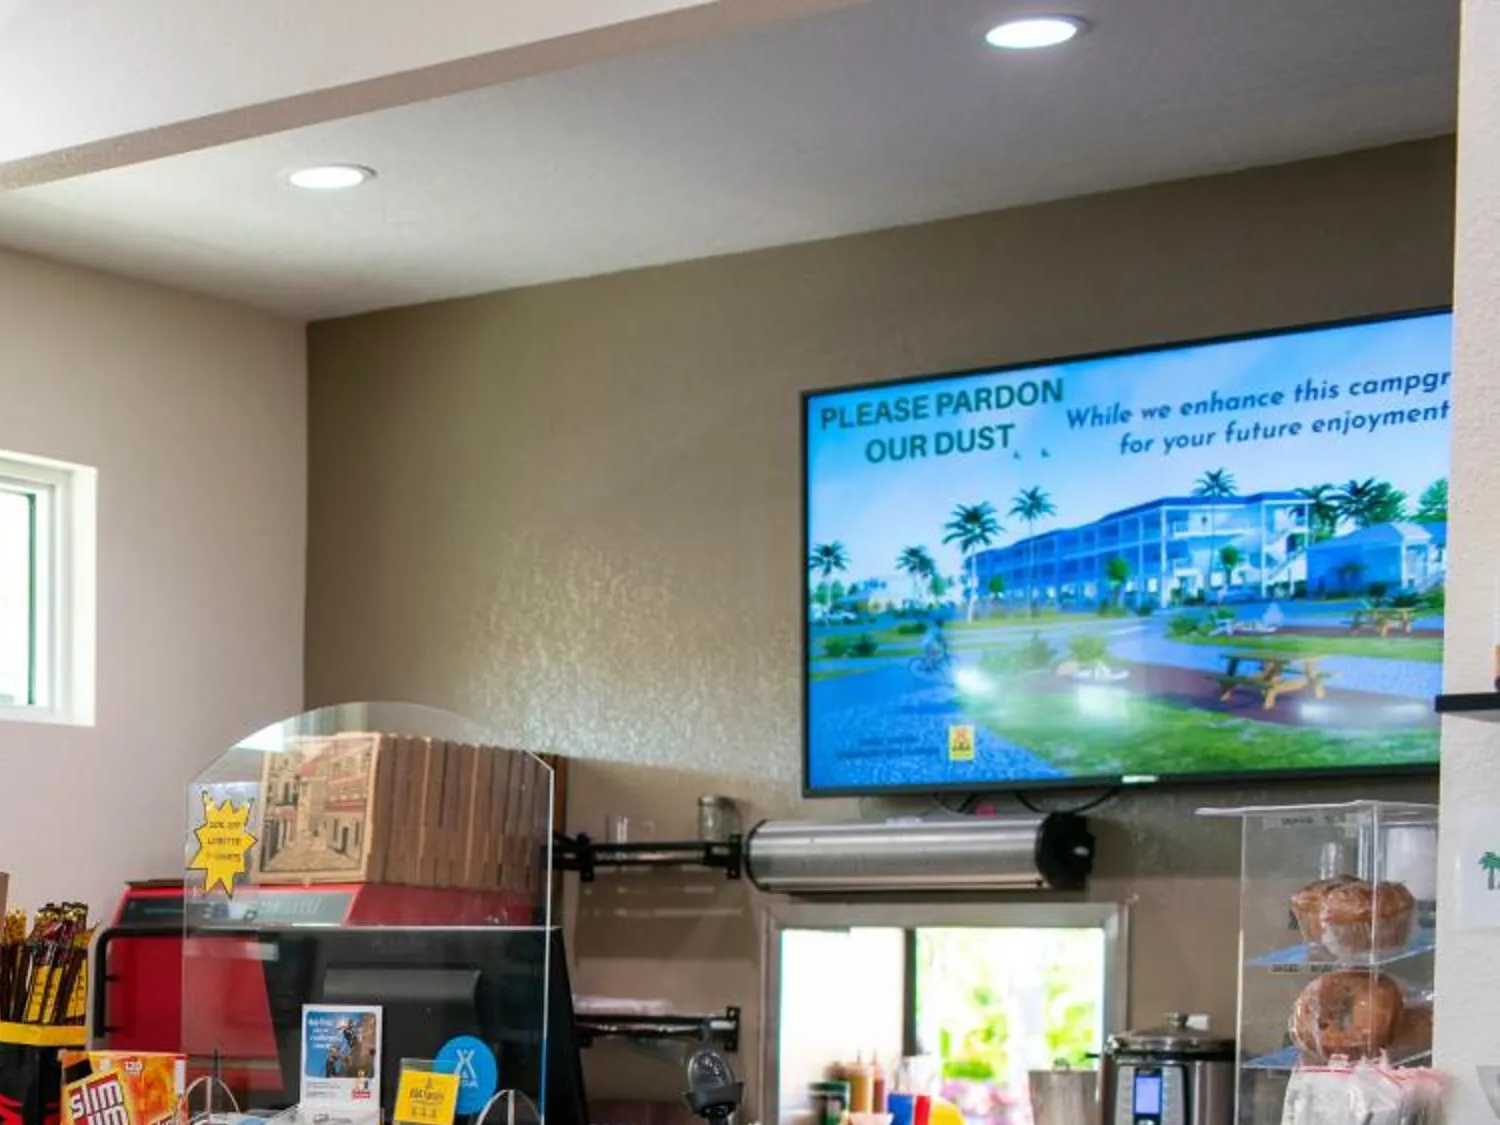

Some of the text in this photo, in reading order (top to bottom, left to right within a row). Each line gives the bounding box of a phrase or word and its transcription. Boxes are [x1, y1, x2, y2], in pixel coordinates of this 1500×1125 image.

[820, 377, 1063, 431] PLEASE PARDON
[1065, 369, 1451, 430] While we enhance this campgr
[865, 423, 1016, 464] OUR DUST
[1120, 399, 1451, 456] for your future enjoyment
